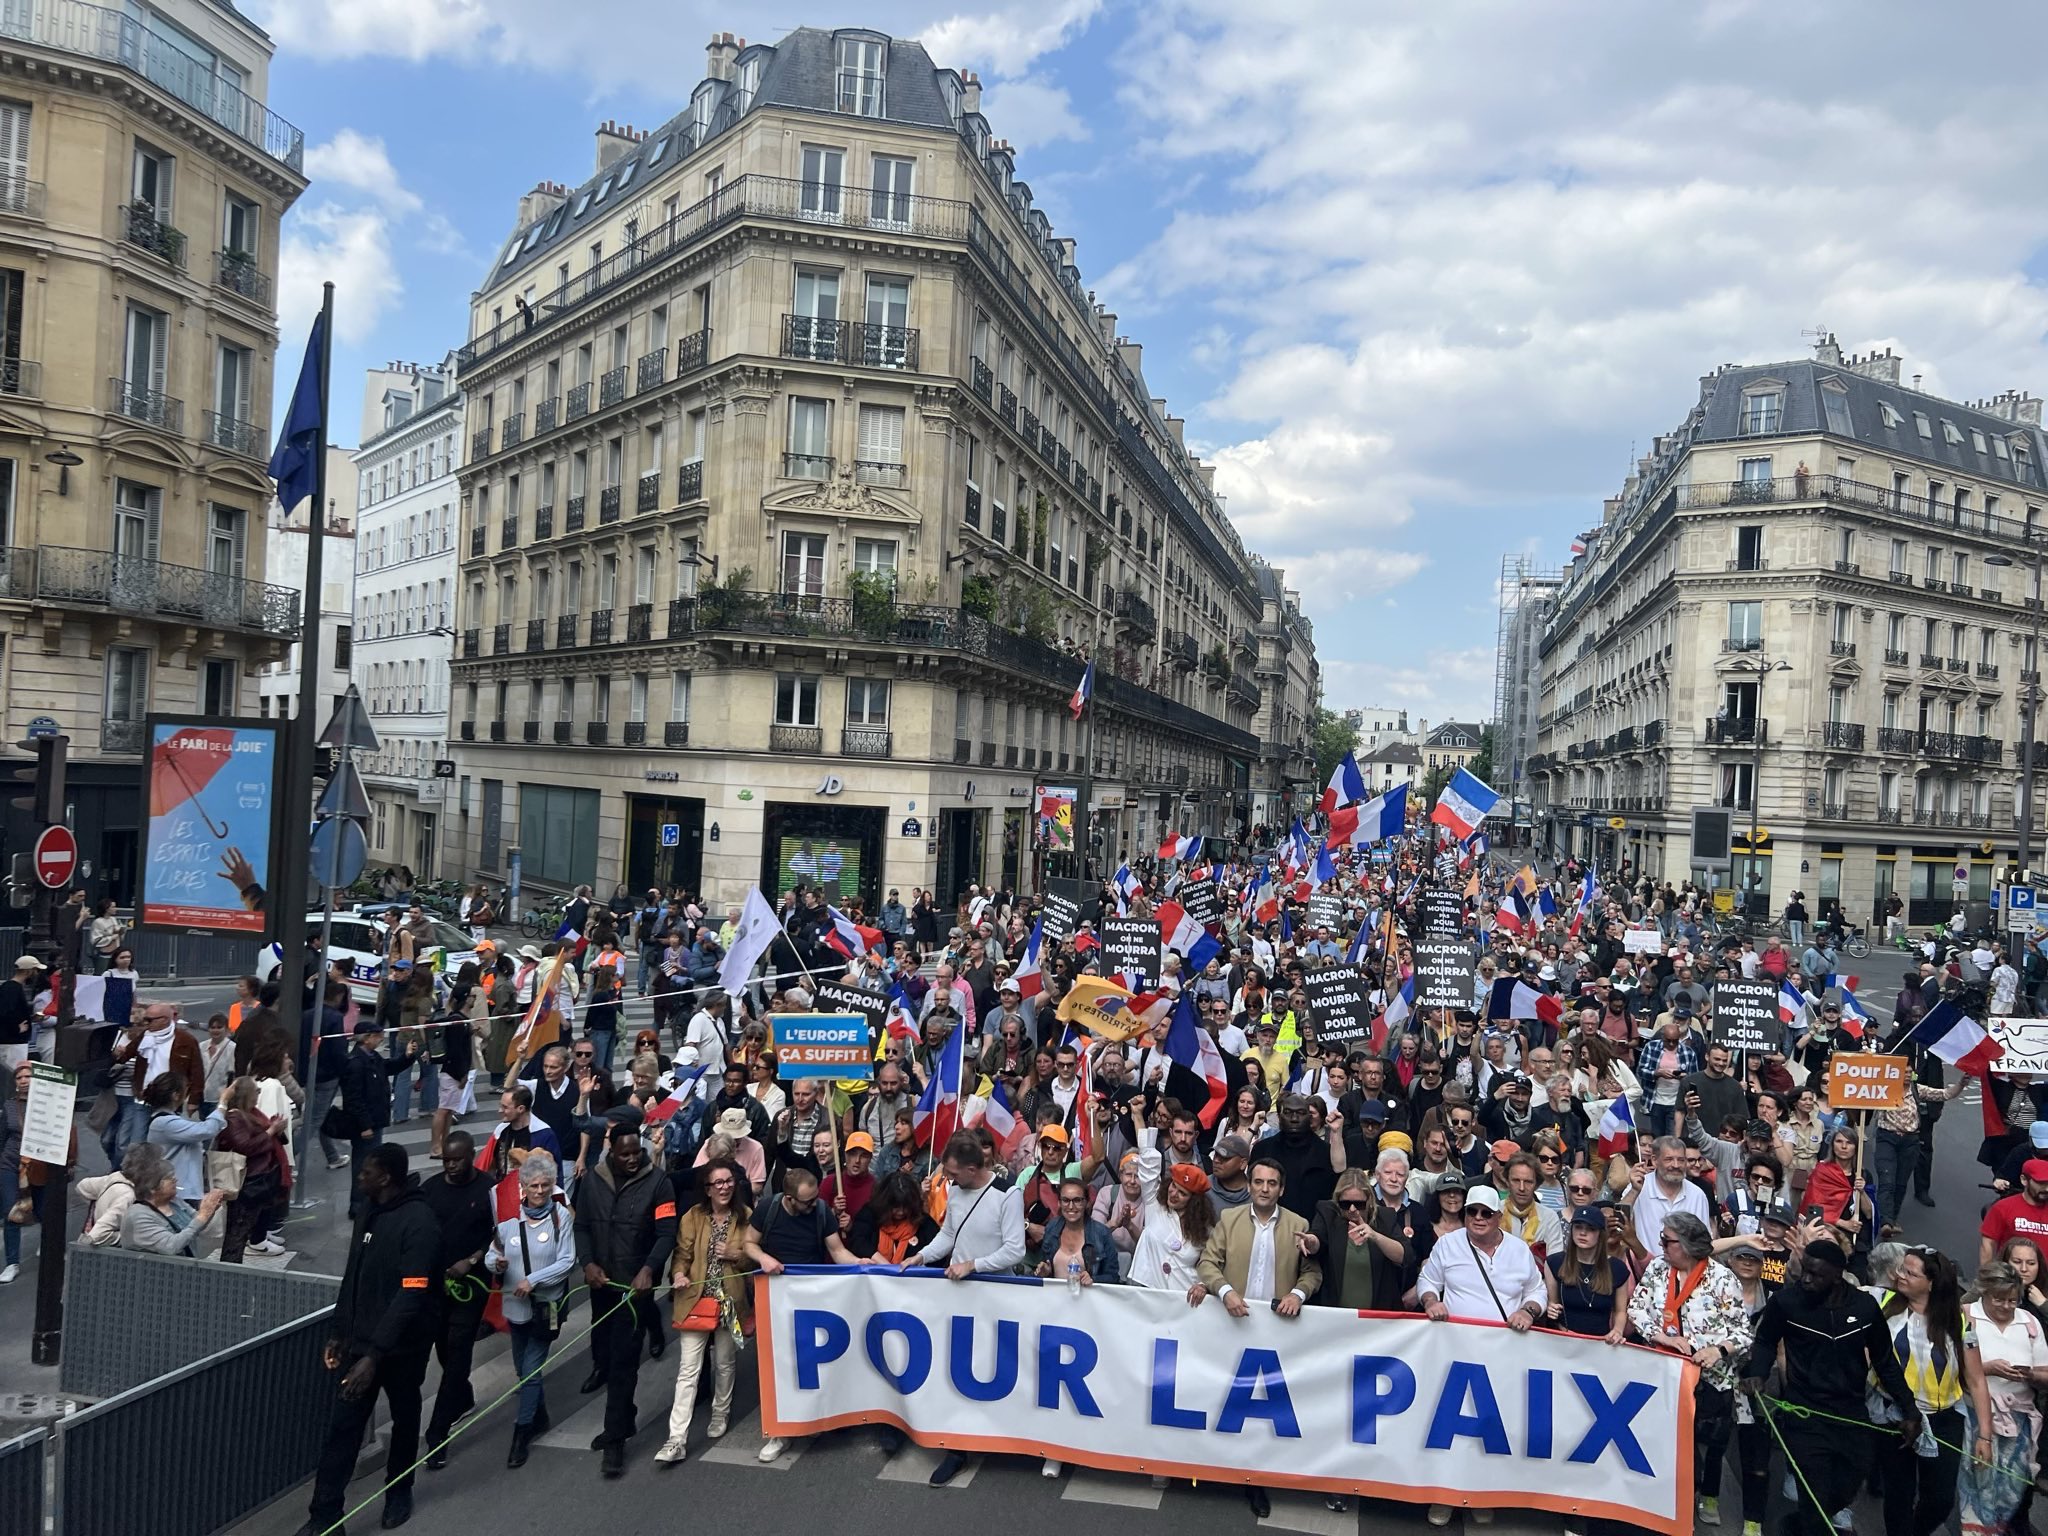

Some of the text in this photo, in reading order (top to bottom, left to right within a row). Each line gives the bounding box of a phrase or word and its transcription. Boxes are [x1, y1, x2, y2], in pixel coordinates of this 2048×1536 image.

[180, 738, 208, 750] PARI
[209, 742, 220, 751] DE
[222, 743, 233, 752] LA
[437, 763, 452, 774] JD
[815, 775, 843, 795] JD
[168, 817, 195, 840] LES
[153, 841, 211, 863] ESPRITS
[154, 865, 207, 894] LIBRES
[1183, 880, 1214, 895] MACRON,
[1047, 892, 1079, 912] MACRON,
[1185, 893, 1215, 908] MOURRA
[1310, 895, 1342, 905] MACRON,
[1425, 891, 1462, 901] MACRON,
[2017, 891, 2029, 905] P
[1043, 905, 1073, 924] MOURRA
[1192, 908, 1212, 919] POUR
[1310, 907, 1340, 916] MOURRA
[1426, 905, 1461, 915] MOURRA
[1043, 920, 1064, 934] POUR
[1051, 917, 1061, 925] PAS
[1433, 919, 1455, 927] POUR
[1105, 921, 1160, 936] MACRON,
[1425, 926, 1459, 934] L'UKRAINE
[1105, 943, 1157, 956] MOURRA
[1416, 944, 1472, 957] MACRON,
[1122, 956, 1139, 964] PAS
[1113, 965, 1147, 976] POUR
[1304, 967, 1359, 986] MACRON,
[1417, 966, 1470, 977] MOURRA
[1322, 984, 1346, 994] ON NE
[1426, 986, 1460, 997] POUR
[1717, 982, 1777, 999] MACRON,
[819, 985, 887, 1014] MACRON,
[1310, 992, 1361, 1009] MOURRA
[1422, 998, 1472, 1007] UKRAINE !
[1733, 997, 1760, 1006] ON NE
[1330, 1007, 1347, 1016] PAS
[1718, 1005, 1775, 1019] MOURRA
[1324, 1016, 1357, 1030] POUR
[1736, 1019, 1756, 1027] PAS
[1316, 1026, 1371, 1042] L'UKRAINE !
[1727, 1027, 1764, 1040] POUR
[1772, 1043, 1777, 1052] !
[780, 1048, 868, 1063] ÇA SUFFIT !
[1835, 1061, 1900, 1079] Pour la
[1843, 1083, 1889, 1100] PAIX
[793, 1309, 1658, 1478] POUR LA PAIX
